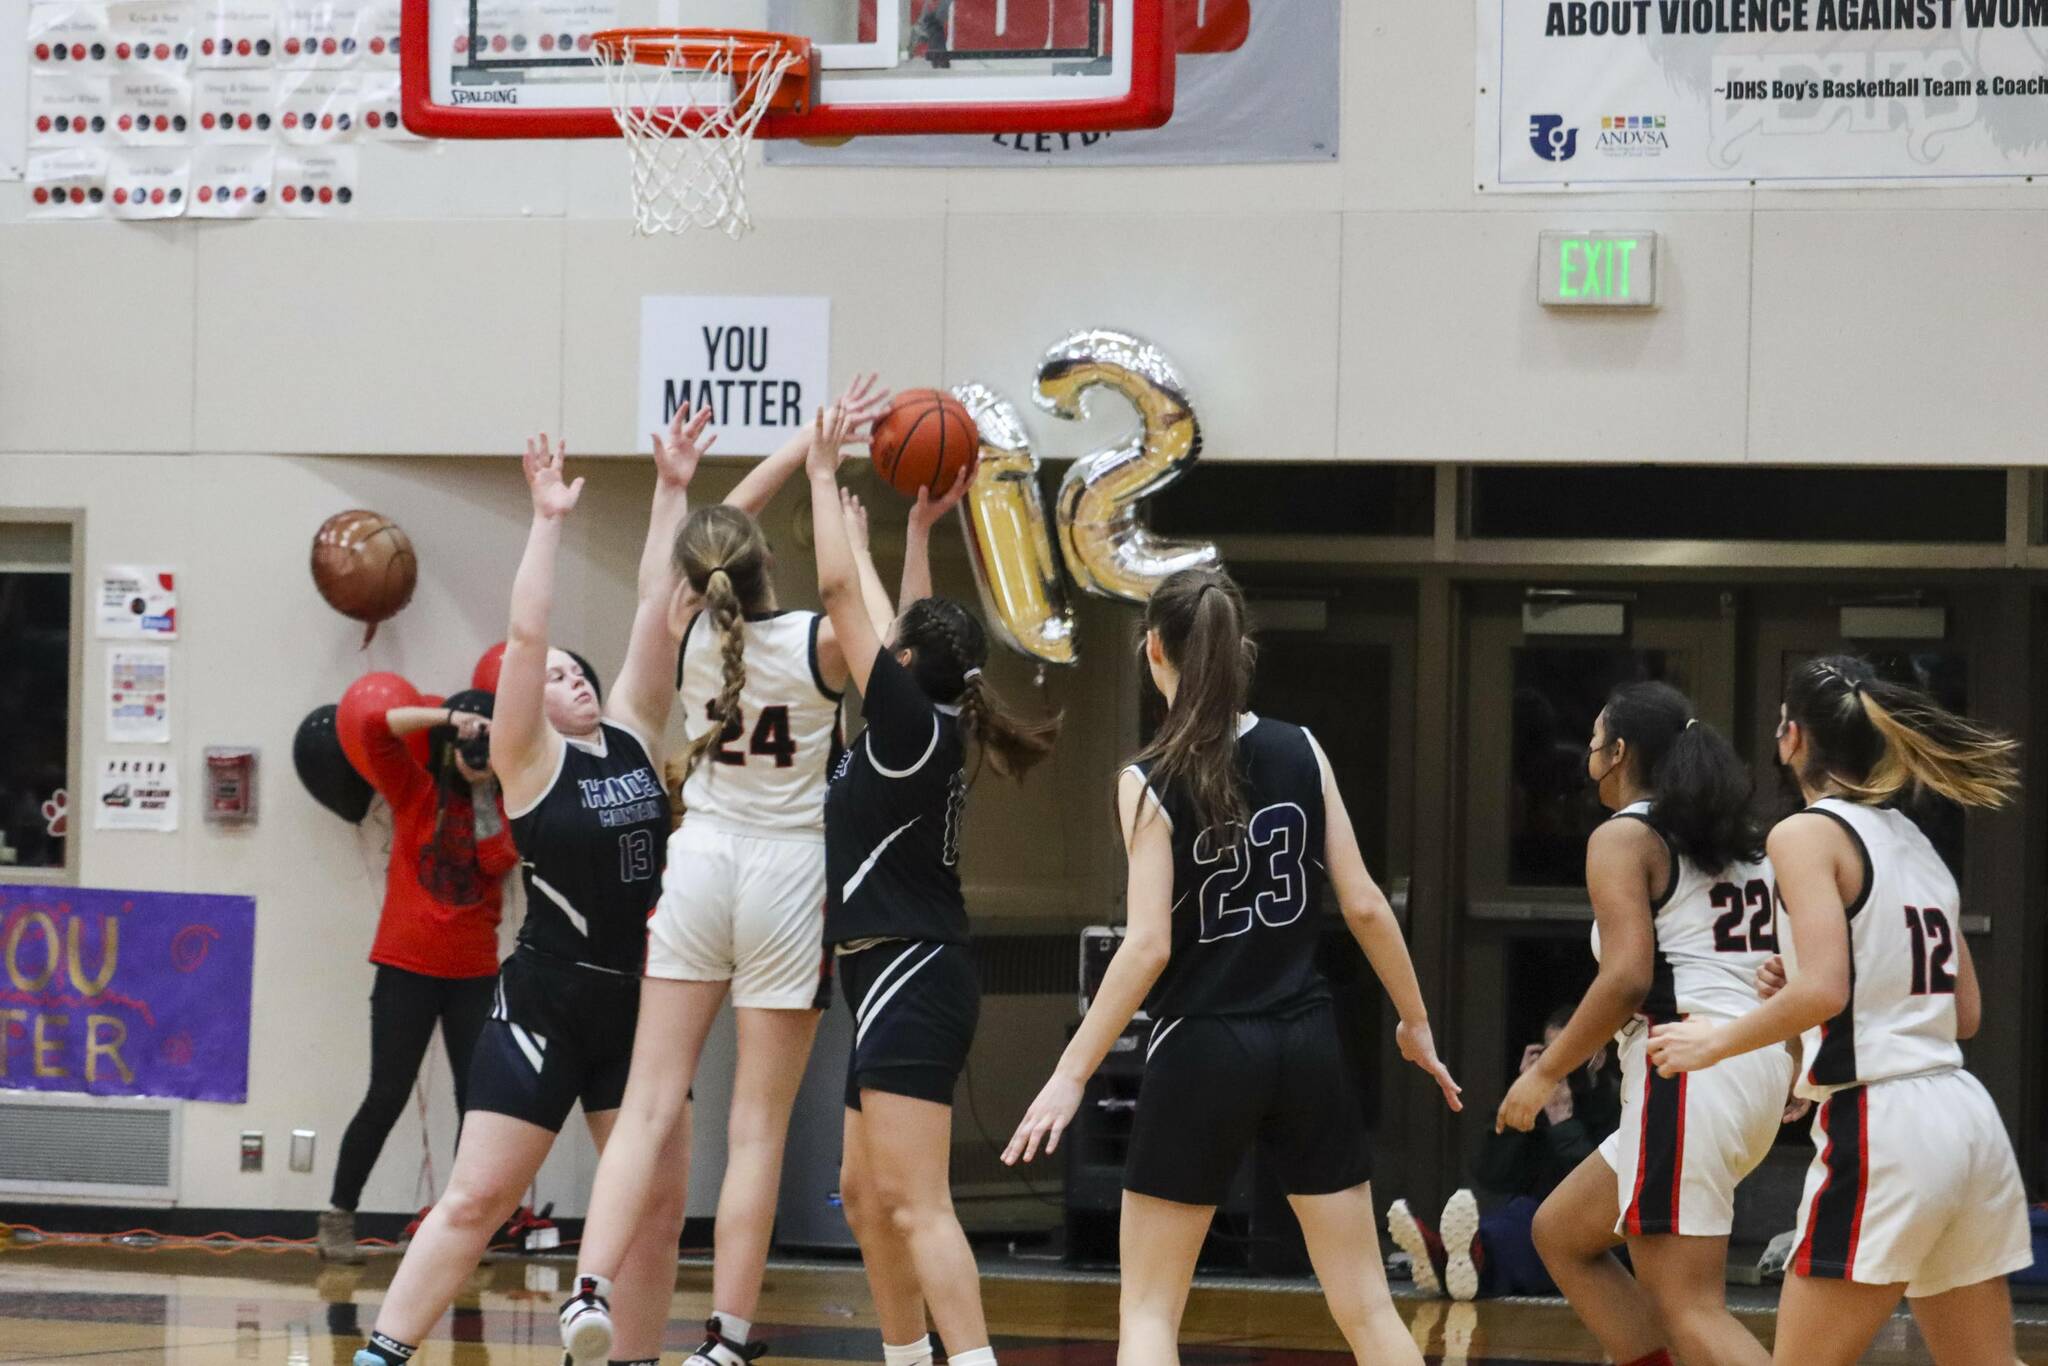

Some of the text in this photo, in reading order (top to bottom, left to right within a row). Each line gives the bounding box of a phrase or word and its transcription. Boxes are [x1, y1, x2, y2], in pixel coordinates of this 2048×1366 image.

[1545, 1, 1651, 36] ABOUT
[1658, 0, 1808, 34] VIOLENCE
[1816, 0, 1952, 32] AGAINST
[451, 88, 517, 105] SPALDING
[1772, 80, 1818, 101] Boy's
[1823, 78, 1918, 98] Basketball
[1923, 78, 1971, 97] Team
[1975, 79, 1989, 96] &
[1992, 76, 2048, 96] Coach
[1595, 131, 1669, 150] ANDVSA
[1559, 239, 1637, 298] EXIT
[702, 326, 767, 372] YOU
[664, 379, 801, 427] MATTER
[705, 698, 796, 768] 24
[619, 829, 654, 883] 13
[1194, 802, 1316, 943] 23
[1708, 878, 1778, 953] 22
[0, 911, 119, 997] OU
[1904, 905, 1955, 995] 12
